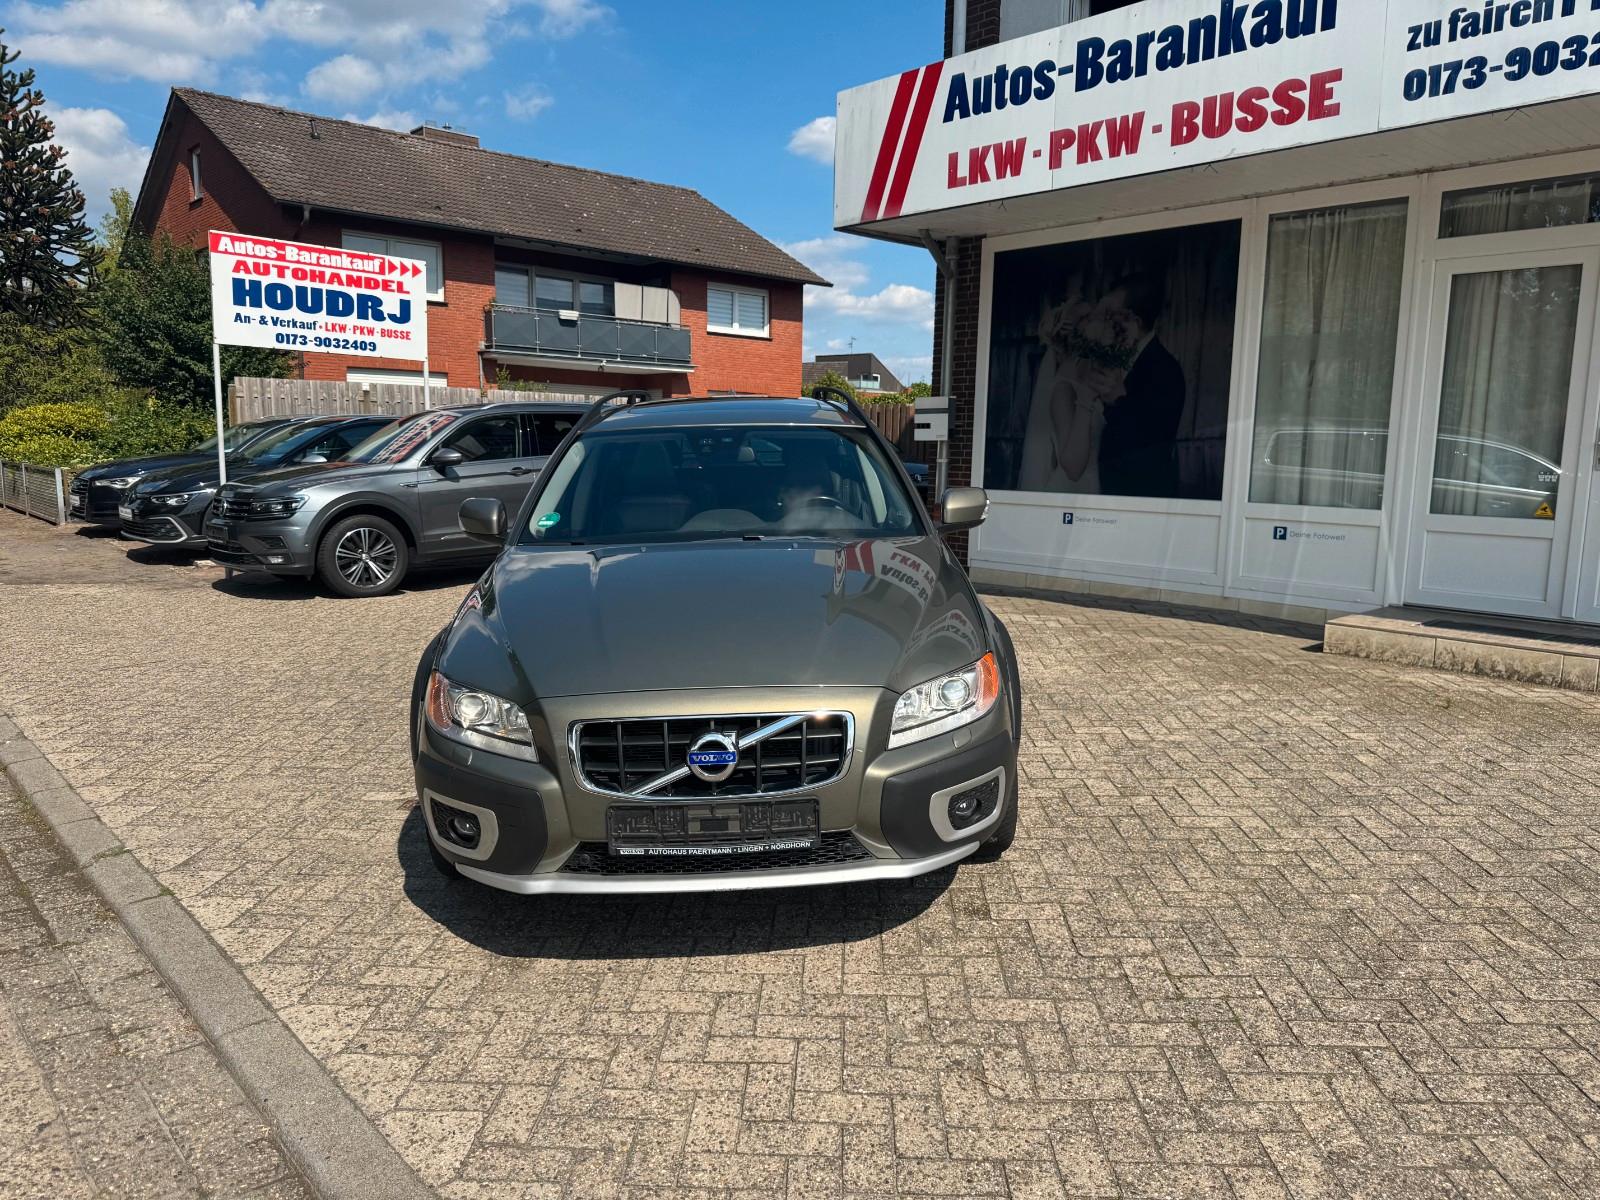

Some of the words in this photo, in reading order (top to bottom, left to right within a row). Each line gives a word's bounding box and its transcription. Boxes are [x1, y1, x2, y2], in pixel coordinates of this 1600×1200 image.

[1406, 23, 1442, 51] zu
[948, 137, 1026, 189] LKW
[1049, 111, 1145, 170] PKW
[1170, 68, 1343, 146] BUSSE
[217, 236, 383, 273] Autos-Barankauf
[231, 259, 410, 294] AUTOHANDEL
[231, 277, 411, 324] HOUDRJ
[234, 312, 256, 324] An-
[259, 315, 268, 325] &
[271, 316, 319, 331] Verkauf
[325, 322, 347, 333] LKW
[353, 325, 375, 336] PKW
[380, 328, 411, 340] BUSSE
[275, 332, 377, 351] 0173-9032409
[1290, 530, 1311, 538] Deine
[691, 753, 734, 762] VOLVO
[688, 847, 731, 855] PAERTMANN
[771, 842, 811, 850] NORDHORN
